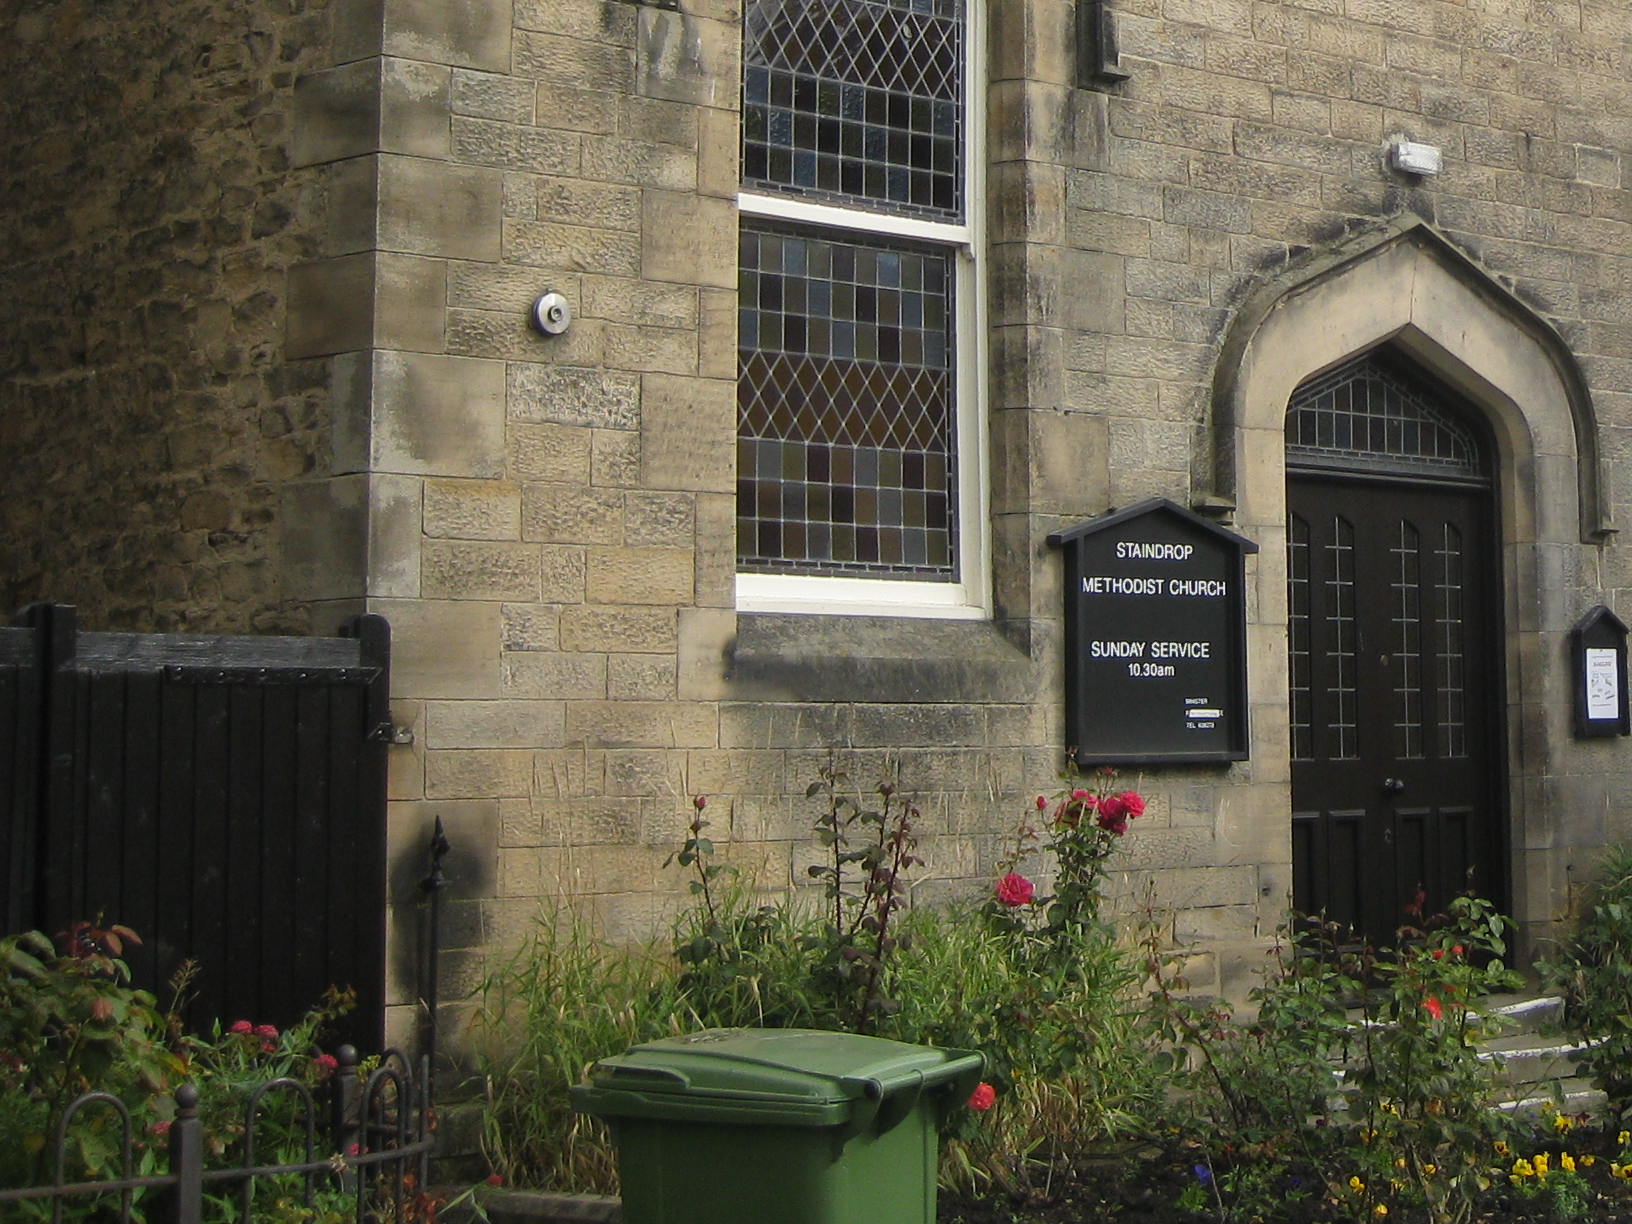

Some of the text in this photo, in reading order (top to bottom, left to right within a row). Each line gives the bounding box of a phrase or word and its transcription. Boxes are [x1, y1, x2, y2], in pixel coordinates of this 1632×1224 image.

[1116, 542, 1193, 560] STAINDROP
[1082, 577, 1226, 596] METHODIST CHURCH
[1091, 641, 1210, 658] SUNDAY SERVICE
[1128, 663, 1175, 676] 10.30am
